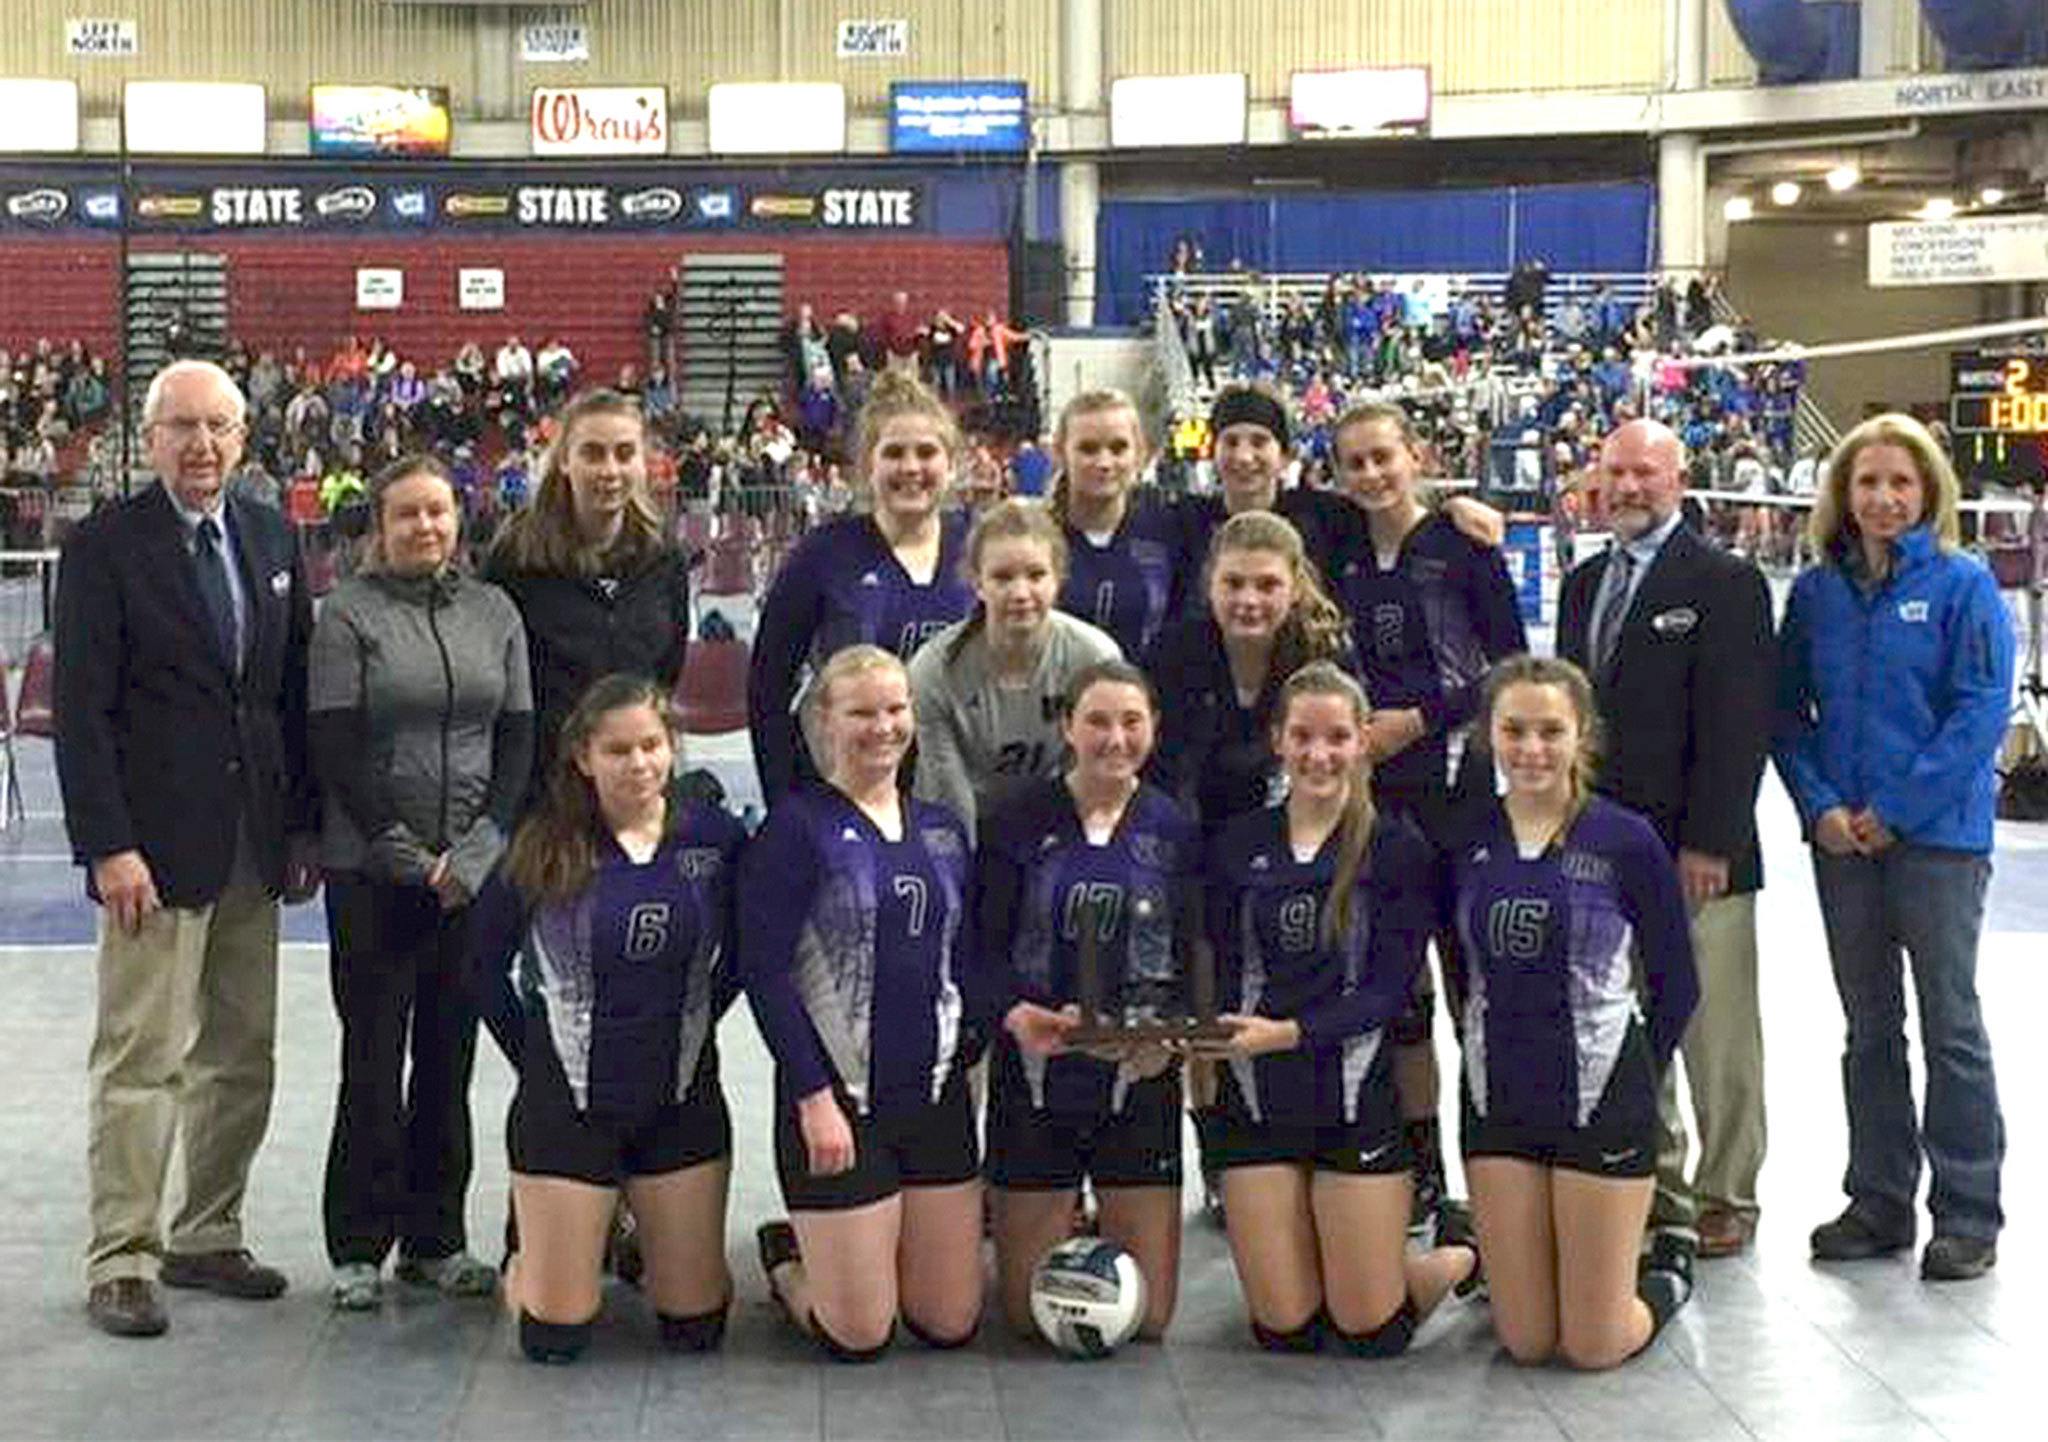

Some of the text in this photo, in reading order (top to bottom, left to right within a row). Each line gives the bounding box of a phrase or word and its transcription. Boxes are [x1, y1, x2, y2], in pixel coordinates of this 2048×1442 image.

[72, 38, 132, 51] NORTH
[81, 22, 120, 35] LEFT
[1896, 77, 2046, 106] NORTH EAST
[536, 93, 662, 144] Wray's
[212, 188, 302, 224] STATE
[517, 186, 608, 223] STATE
[823, 188, 912, 225] STATE
[2005, 360, 2030, 395] 2
[893, 875, 928, 937] 7
[1062, 881, 1126, 942] 17
[1280, 894, 1316, 952] 9
[625, 902, 671, 961] 6
[1489, 898, 1550, 959] 15
